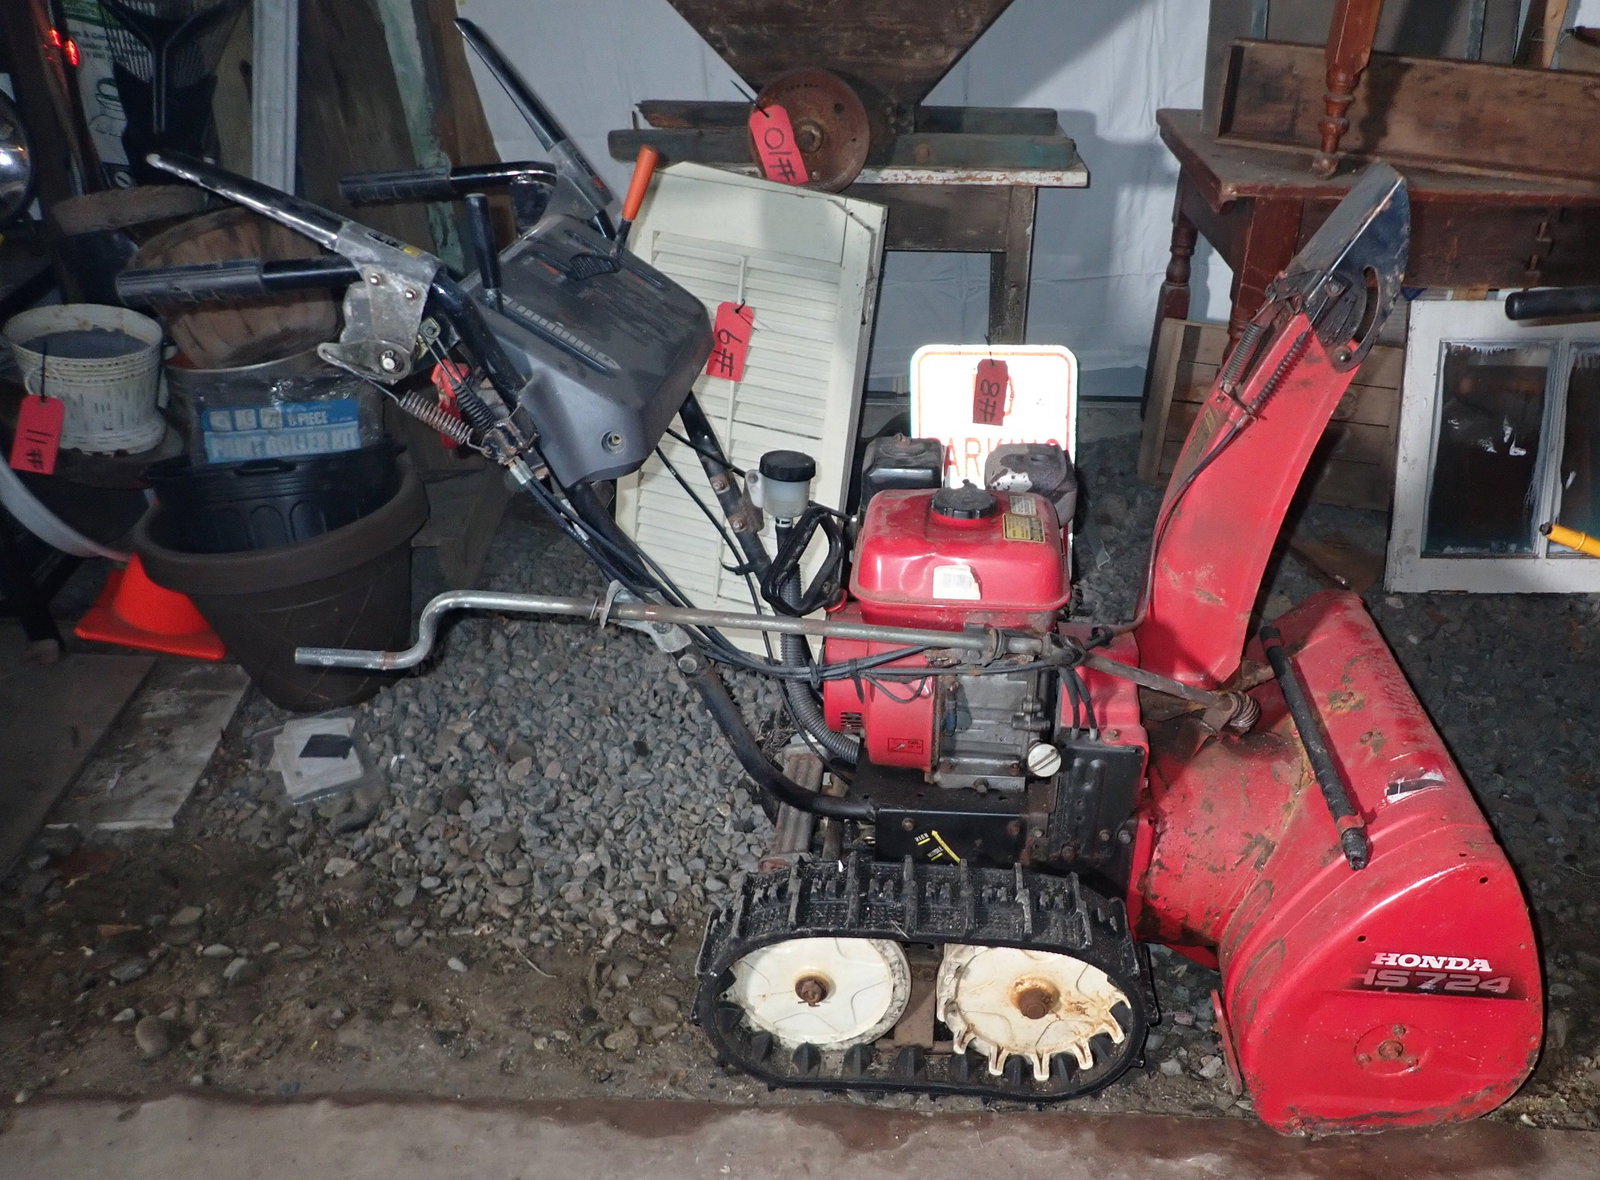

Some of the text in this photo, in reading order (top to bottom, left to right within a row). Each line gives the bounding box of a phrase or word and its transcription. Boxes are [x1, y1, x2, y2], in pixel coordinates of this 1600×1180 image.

[713, 328, 743, 377] #9
[977, 378, 1001, 424] #8
[25, 428, 55, 471] #11
[1371, 952, 1493, 972] HONDA
